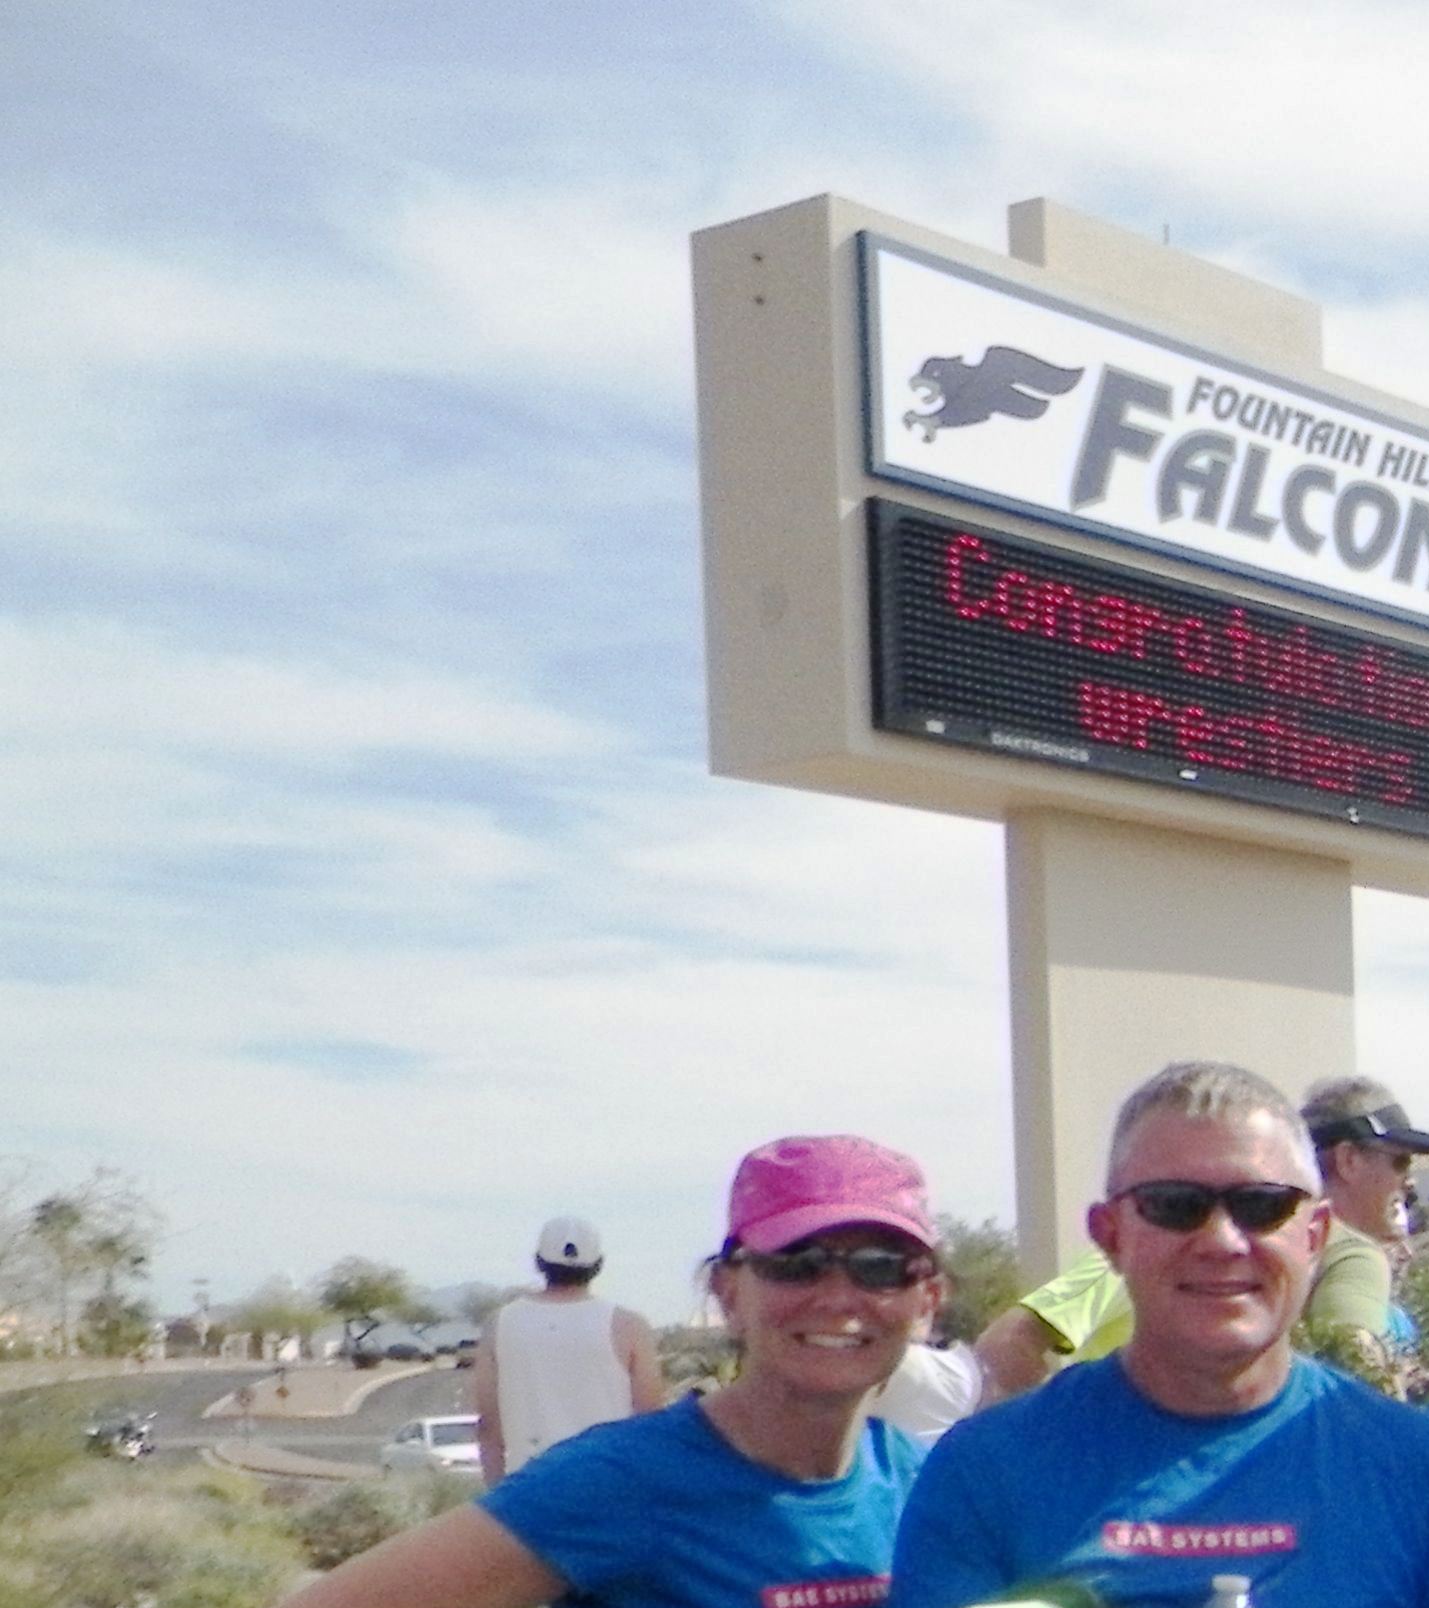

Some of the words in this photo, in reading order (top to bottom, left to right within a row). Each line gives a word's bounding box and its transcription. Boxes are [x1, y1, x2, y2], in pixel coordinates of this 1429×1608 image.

[1185, 374, 1372, 468] FOUNTAIN
[1115, 1523, 1163, 1548] BAE
[1171, 1528, 1287, 1549] SYSTEMS
[774, 1587, 819, 1608] BAE
